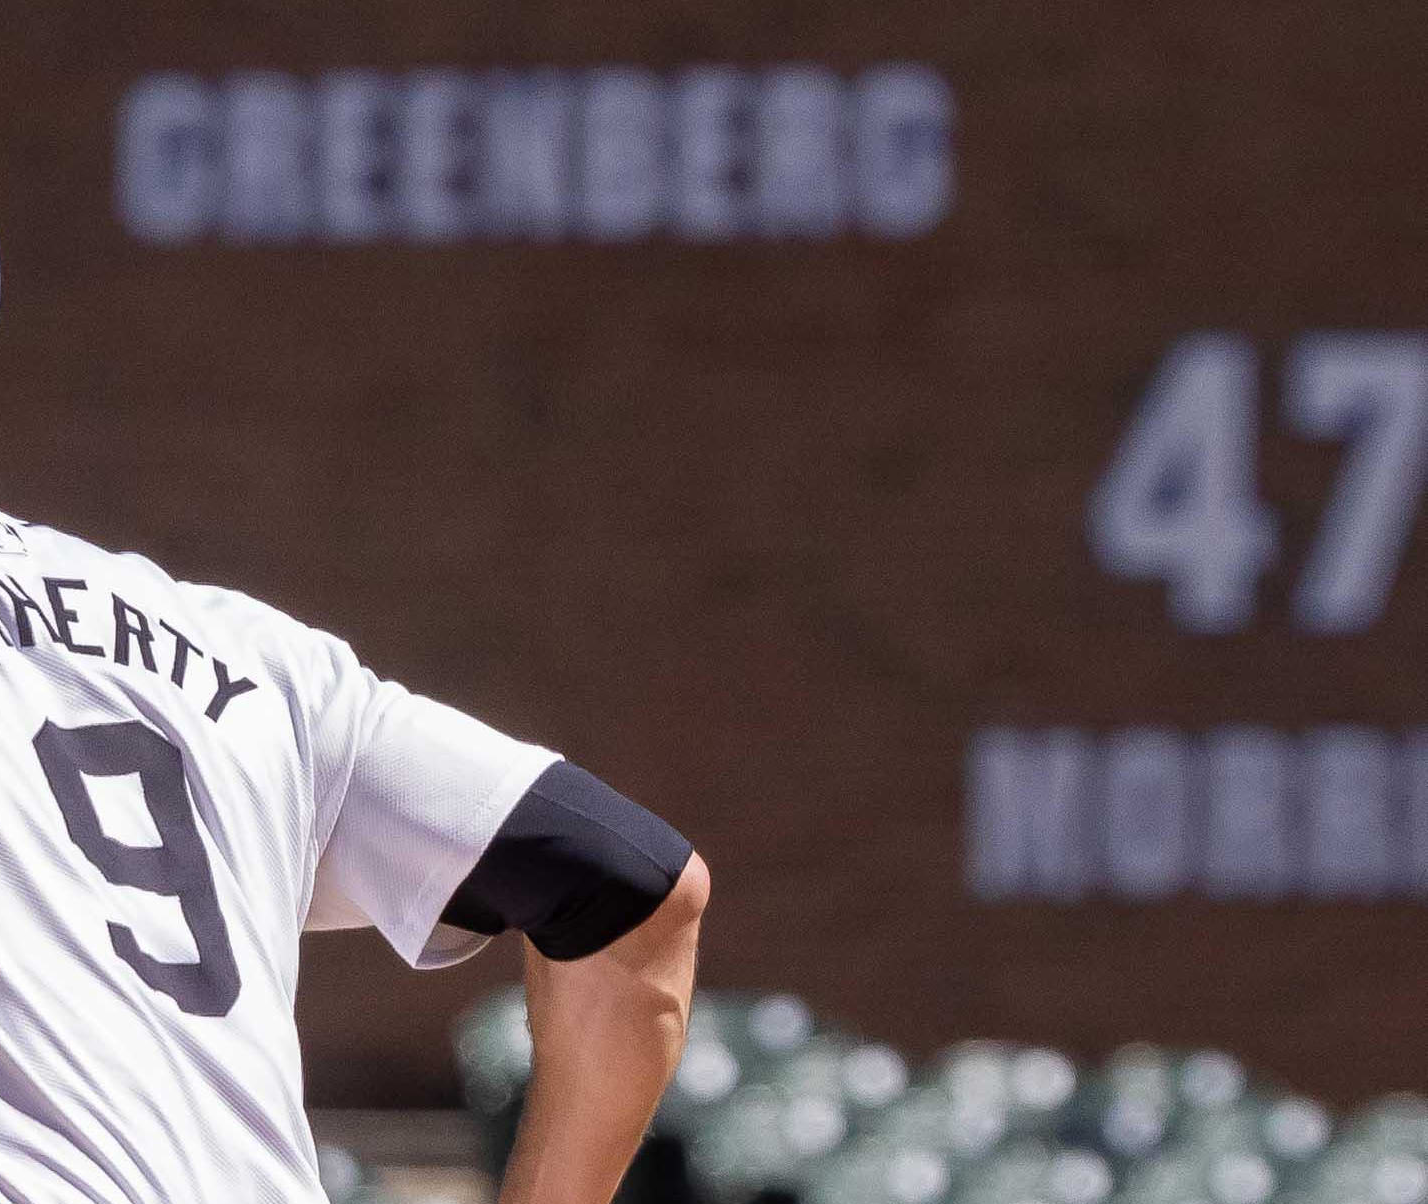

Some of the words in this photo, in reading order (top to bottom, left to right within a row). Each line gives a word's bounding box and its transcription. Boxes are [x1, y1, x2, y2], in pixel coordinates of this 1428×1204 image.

[116, 63, 953, 243] GREENBERG
[1085, 330, 1428, 636] 47
[31, 717, 241, 1018] 9
